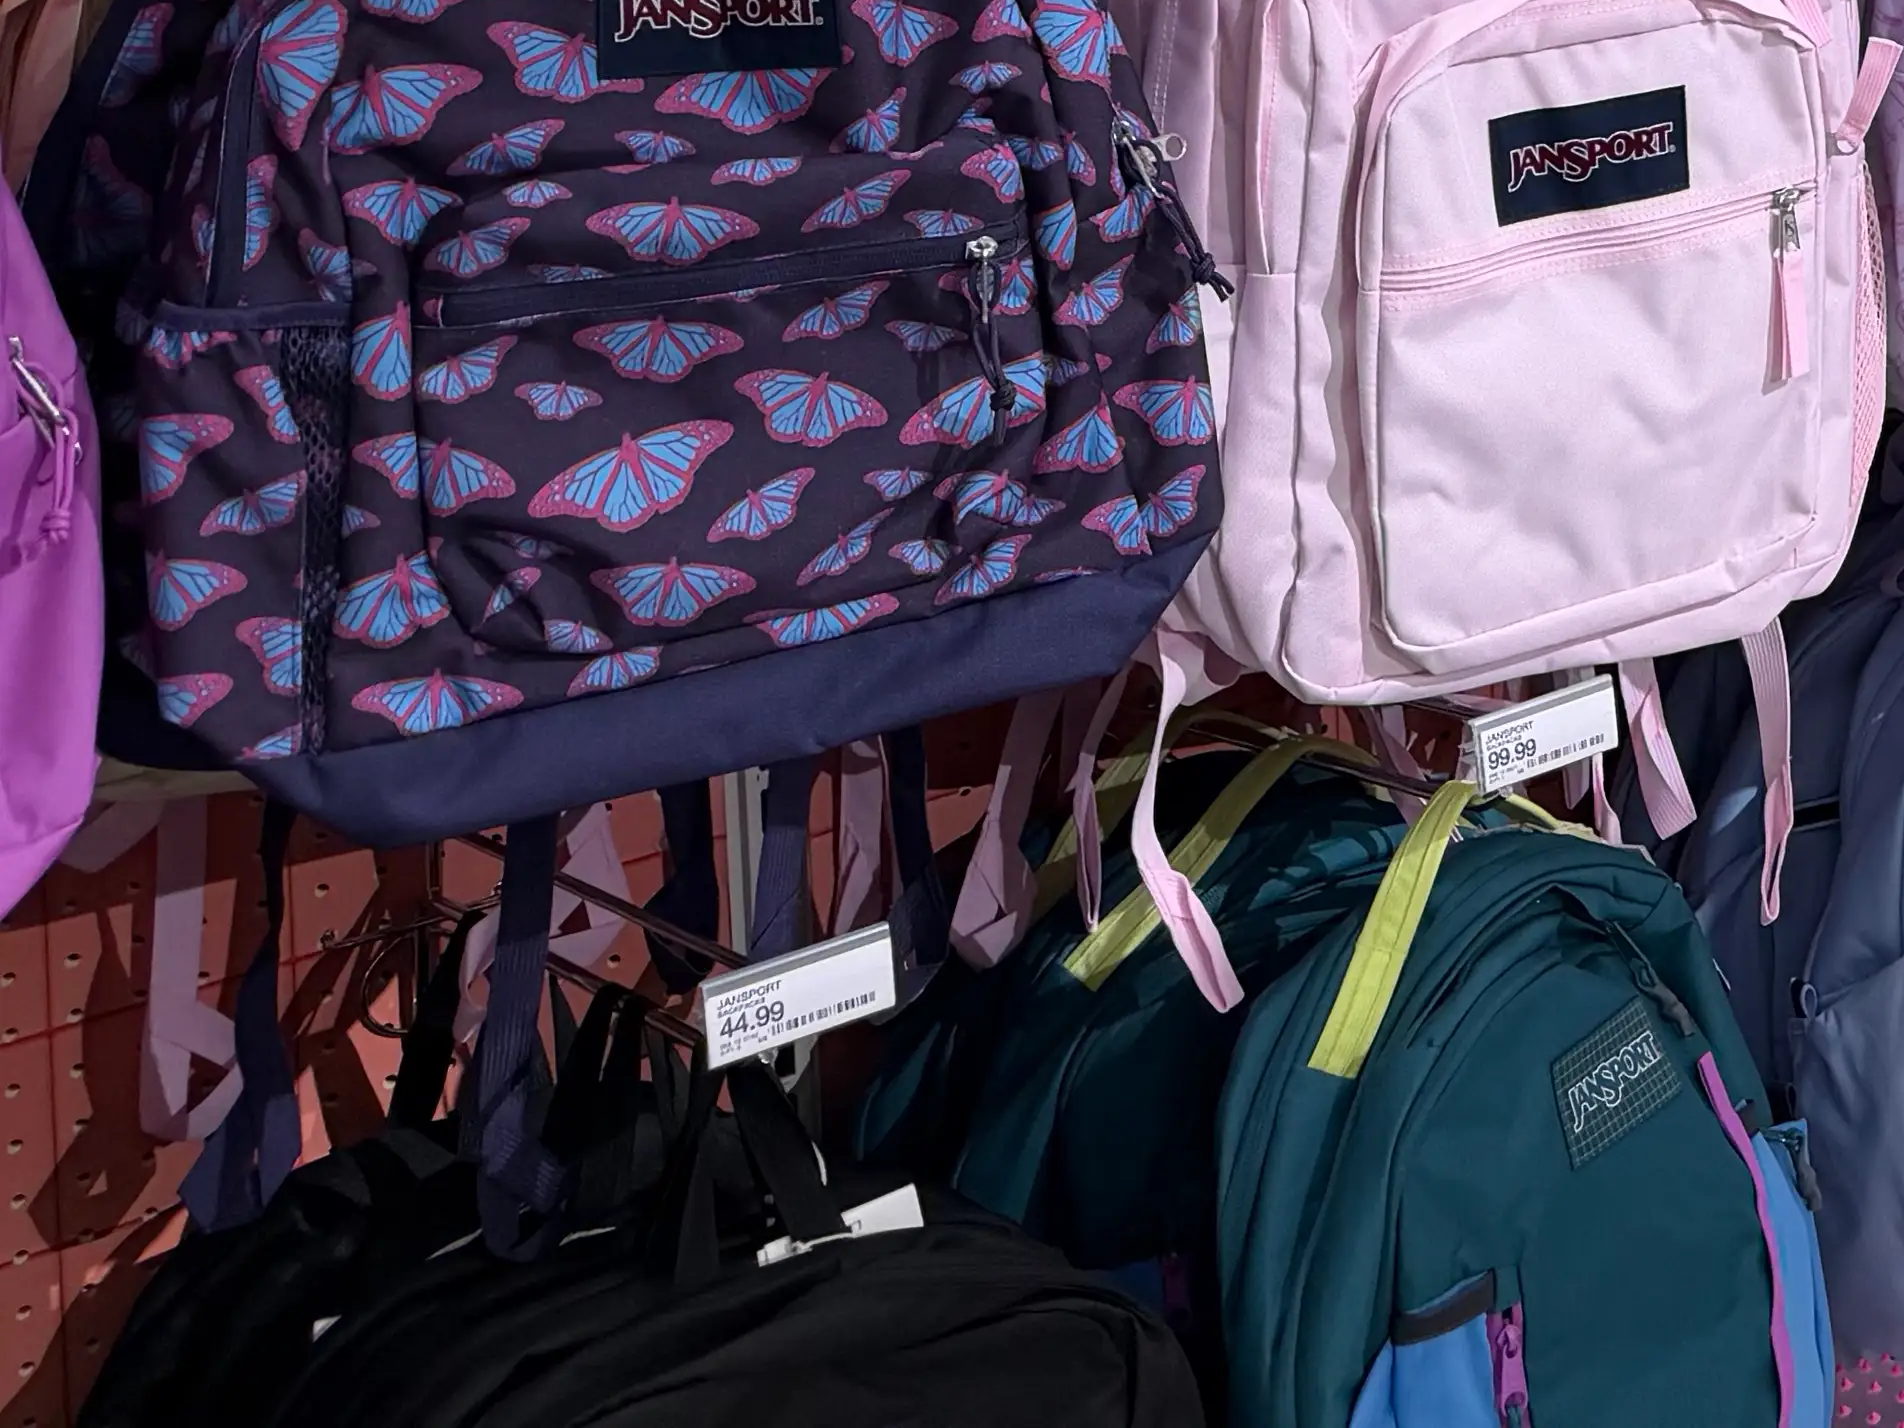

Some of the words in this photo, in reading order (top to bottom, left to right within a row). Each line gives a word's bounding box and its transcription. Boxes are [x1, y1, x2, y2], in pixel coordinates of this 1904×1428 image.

[1507, 122, 1677, 193] JANSPORT
[1486, 720, 1534, 745] JANSPORT
[1488, 738, 1537, 771] 99.99
[717, 980, 782, 1012] JANSPORT
[720, 1000, 786, 1039] 44.99
[1568, 1030, 1662, 1134] JANSPORT
